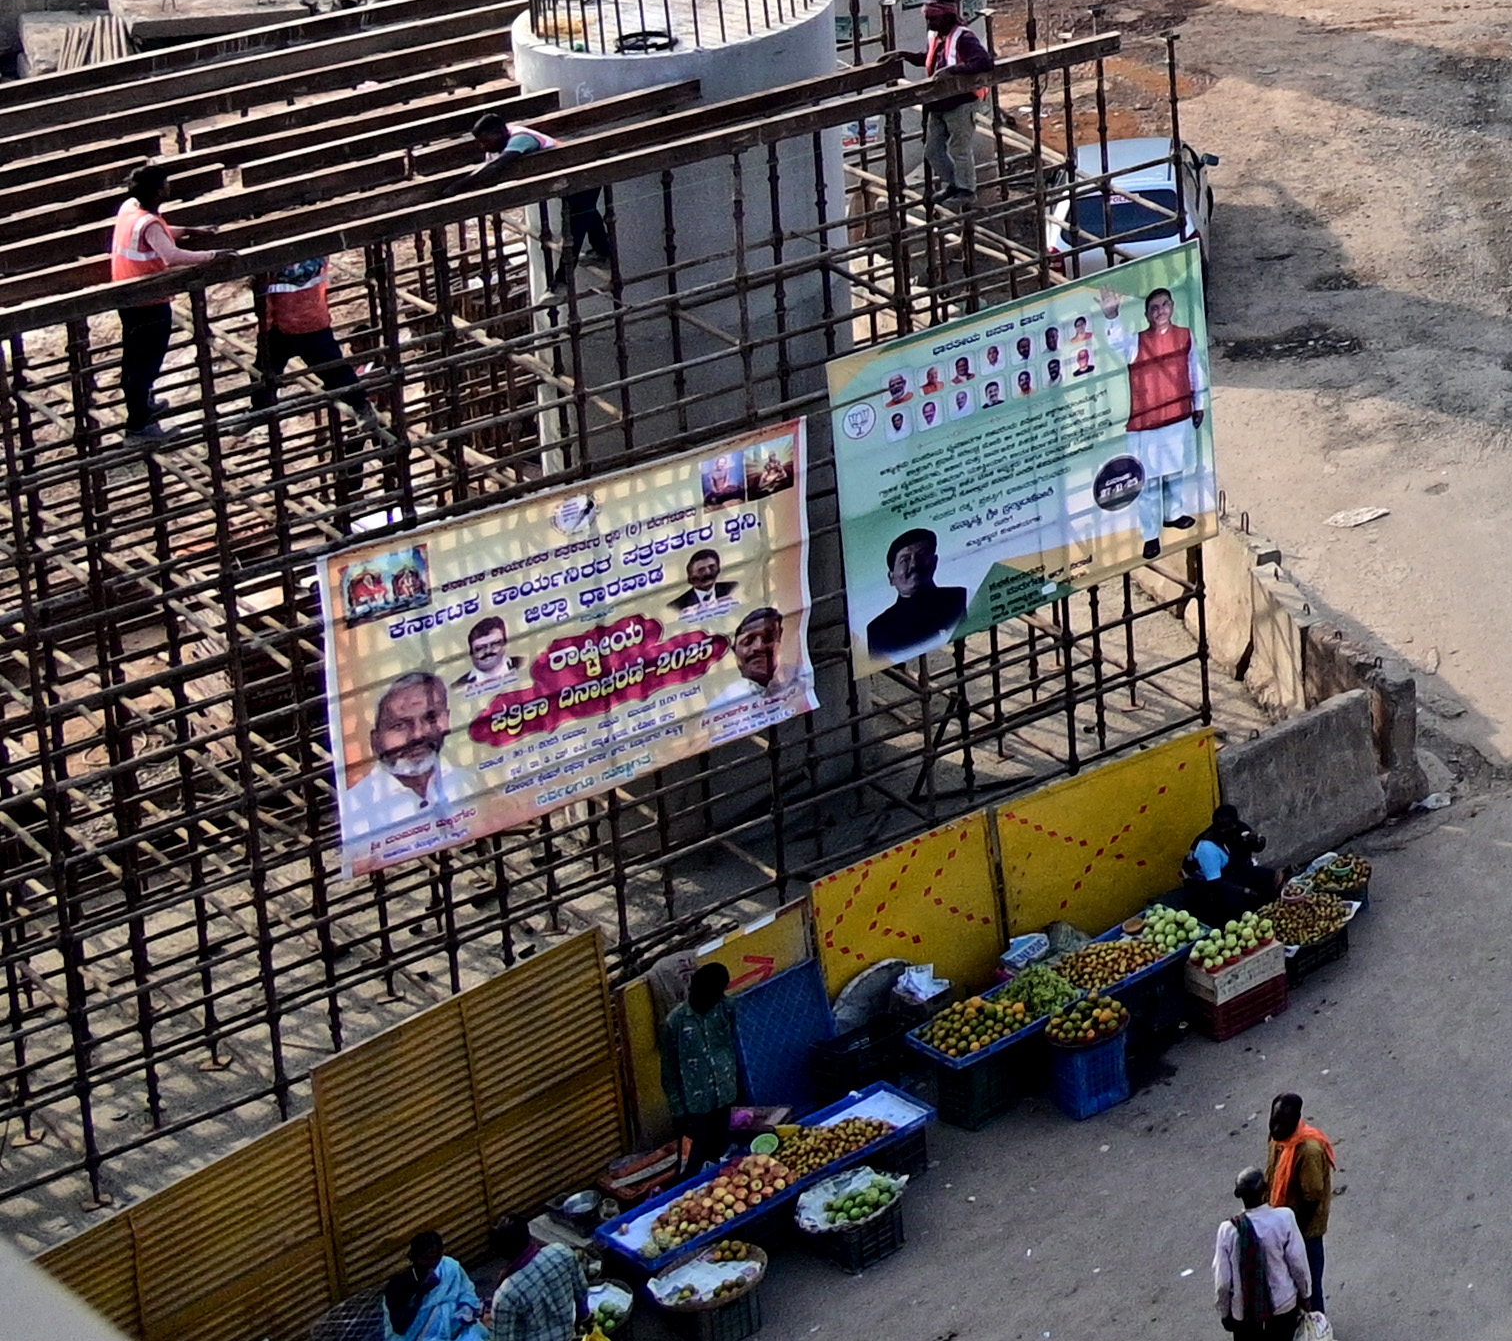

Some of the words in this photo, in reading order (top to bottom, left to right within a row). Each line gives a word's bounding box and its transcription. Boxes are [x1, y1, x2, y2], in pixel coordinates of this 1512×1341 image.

[388, 595, 482, 640] ಕರ್ನಾಟಕ
[491, 554, 614, 606] ಕಾರ್ಯನಿರತ
[622, 526, 715, 567] ಪತ್ರಕರ್ತರ
[523, 597, 571, 626] ಜಿಲ್ಲಾ
[579, 566, 666, 609] ಧಾರವಾಡ
[548, 621, 646, 681] ರಾಷ್ಟ್ರೀಯ
[491, 698, 550, 735] ಪತ್ರಿಕಾ
